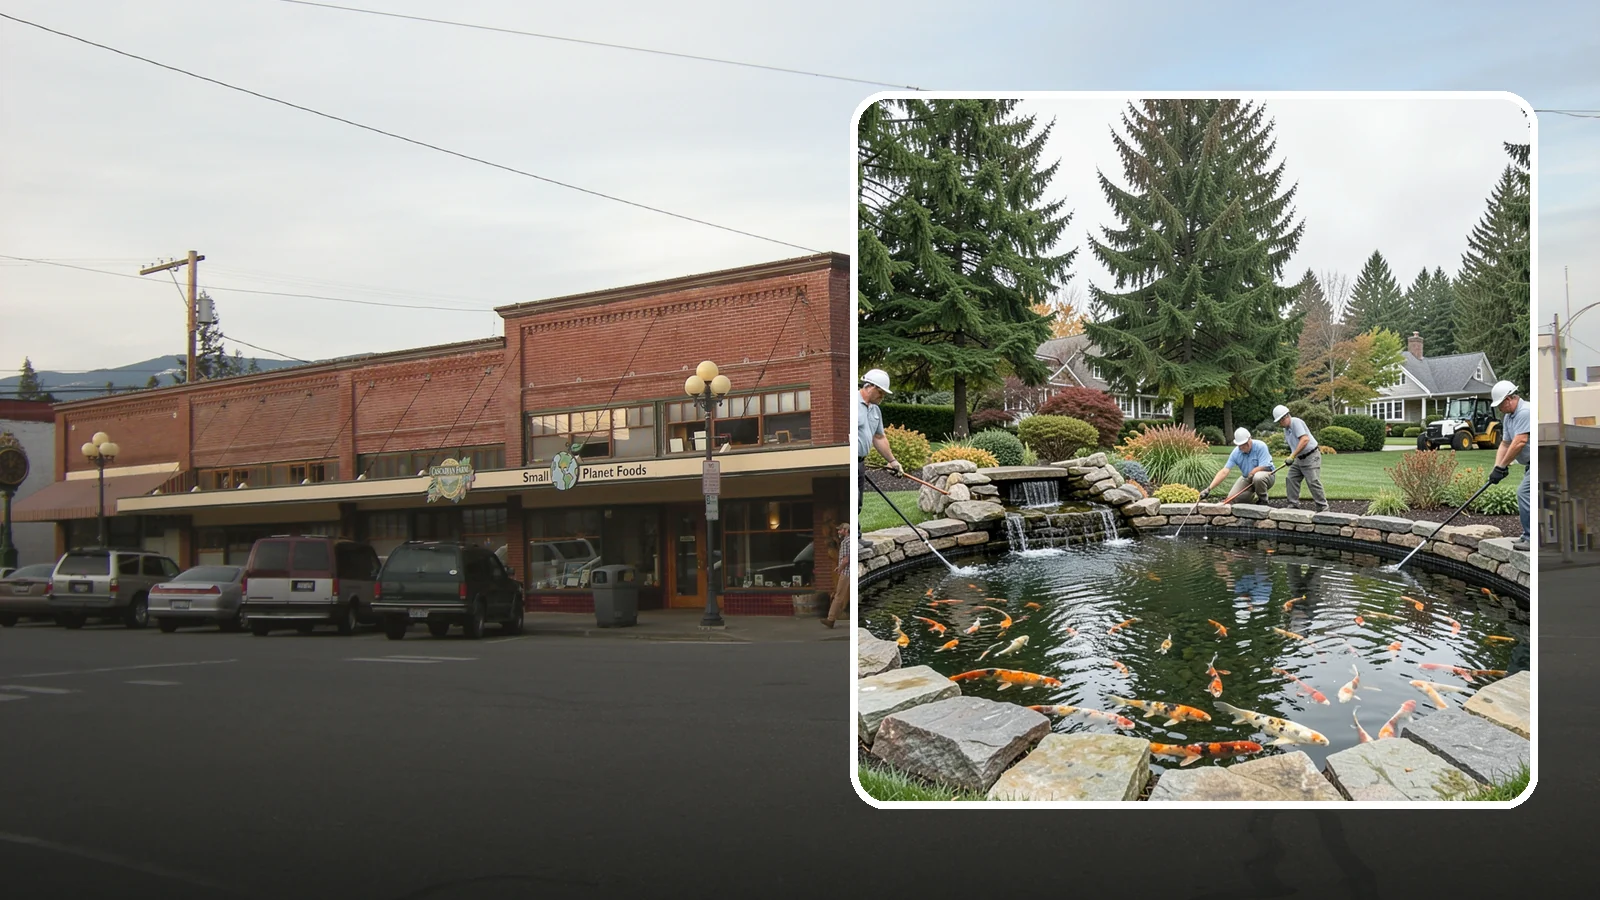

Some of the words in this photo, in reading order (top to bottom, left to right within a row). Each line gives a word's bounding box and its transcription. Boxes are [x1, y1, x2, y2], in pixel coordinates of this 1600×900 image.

[523, 471, 548, 482] Small
[583, 467, 614, 479] Planet
[617, 464, 647, 477] Foods
